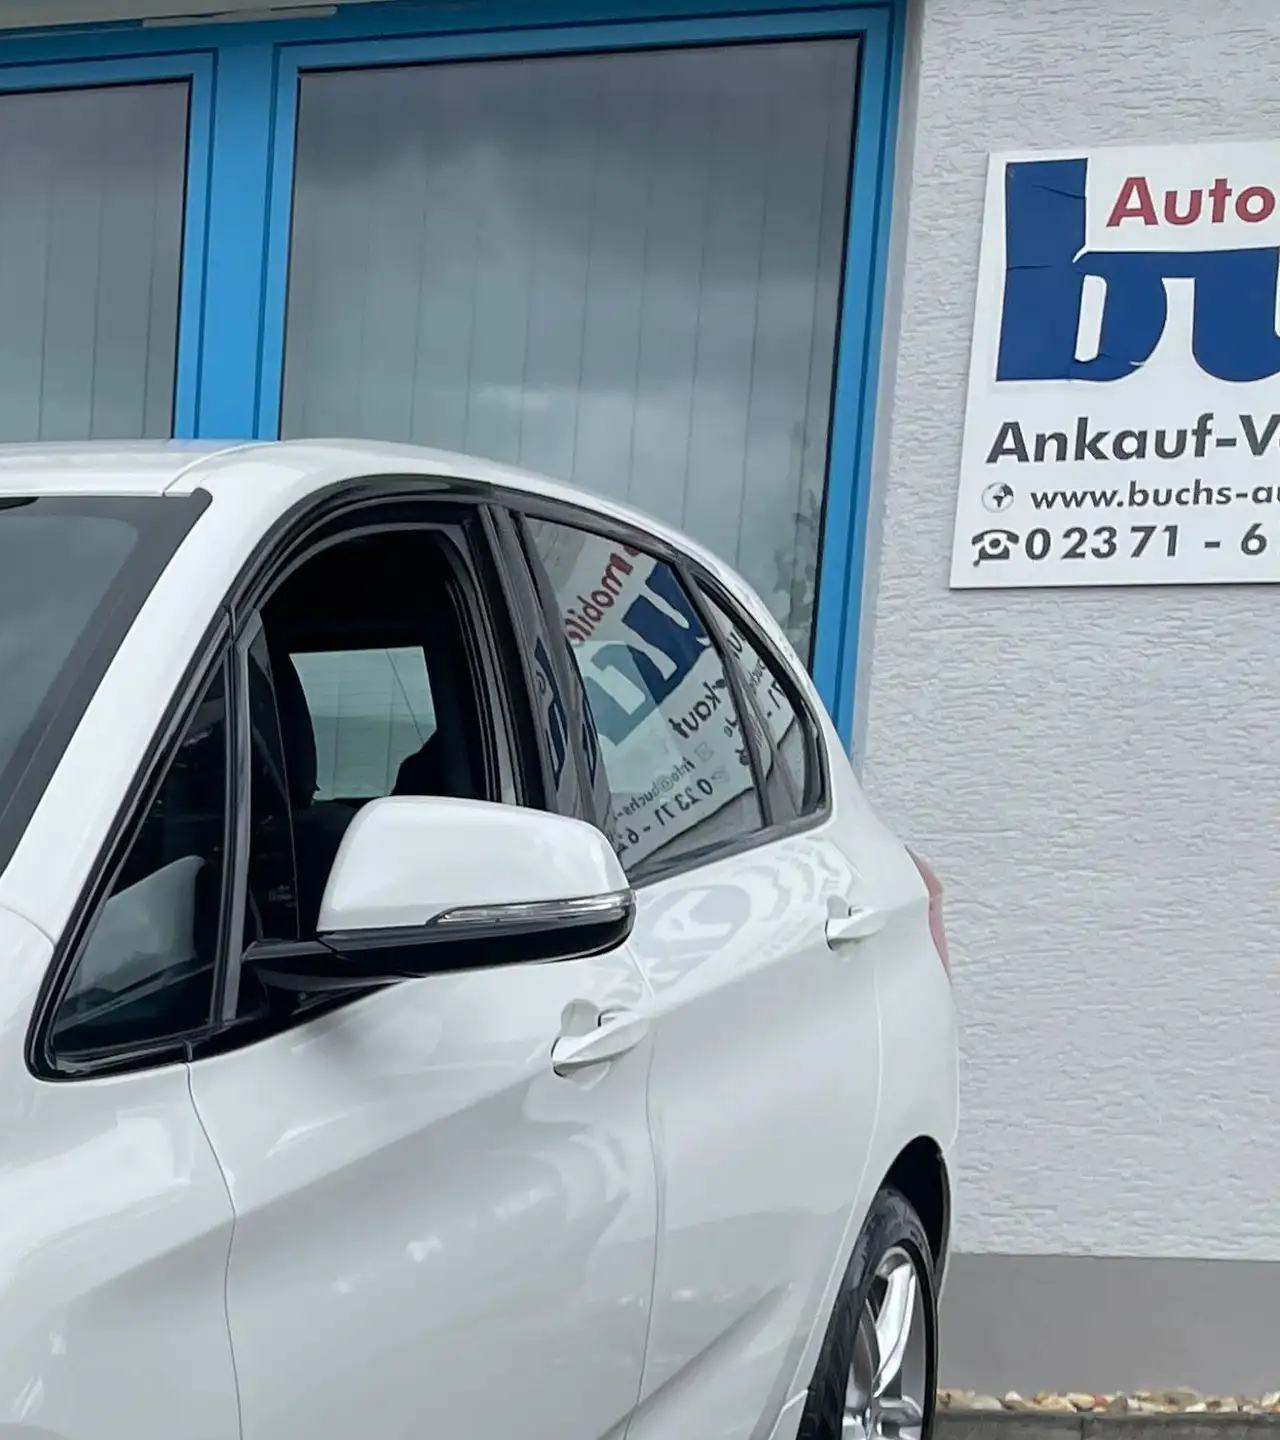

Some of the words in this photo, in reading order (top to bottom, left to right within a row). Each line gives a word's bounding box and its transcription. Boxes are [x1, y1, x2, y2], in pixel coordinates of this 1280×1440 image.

[1106, 177, 1276, 227] Auto
[986, 412, 1280, 463] Ankauf-V
[1030, 478, 1280, 510] www.buchs-a
